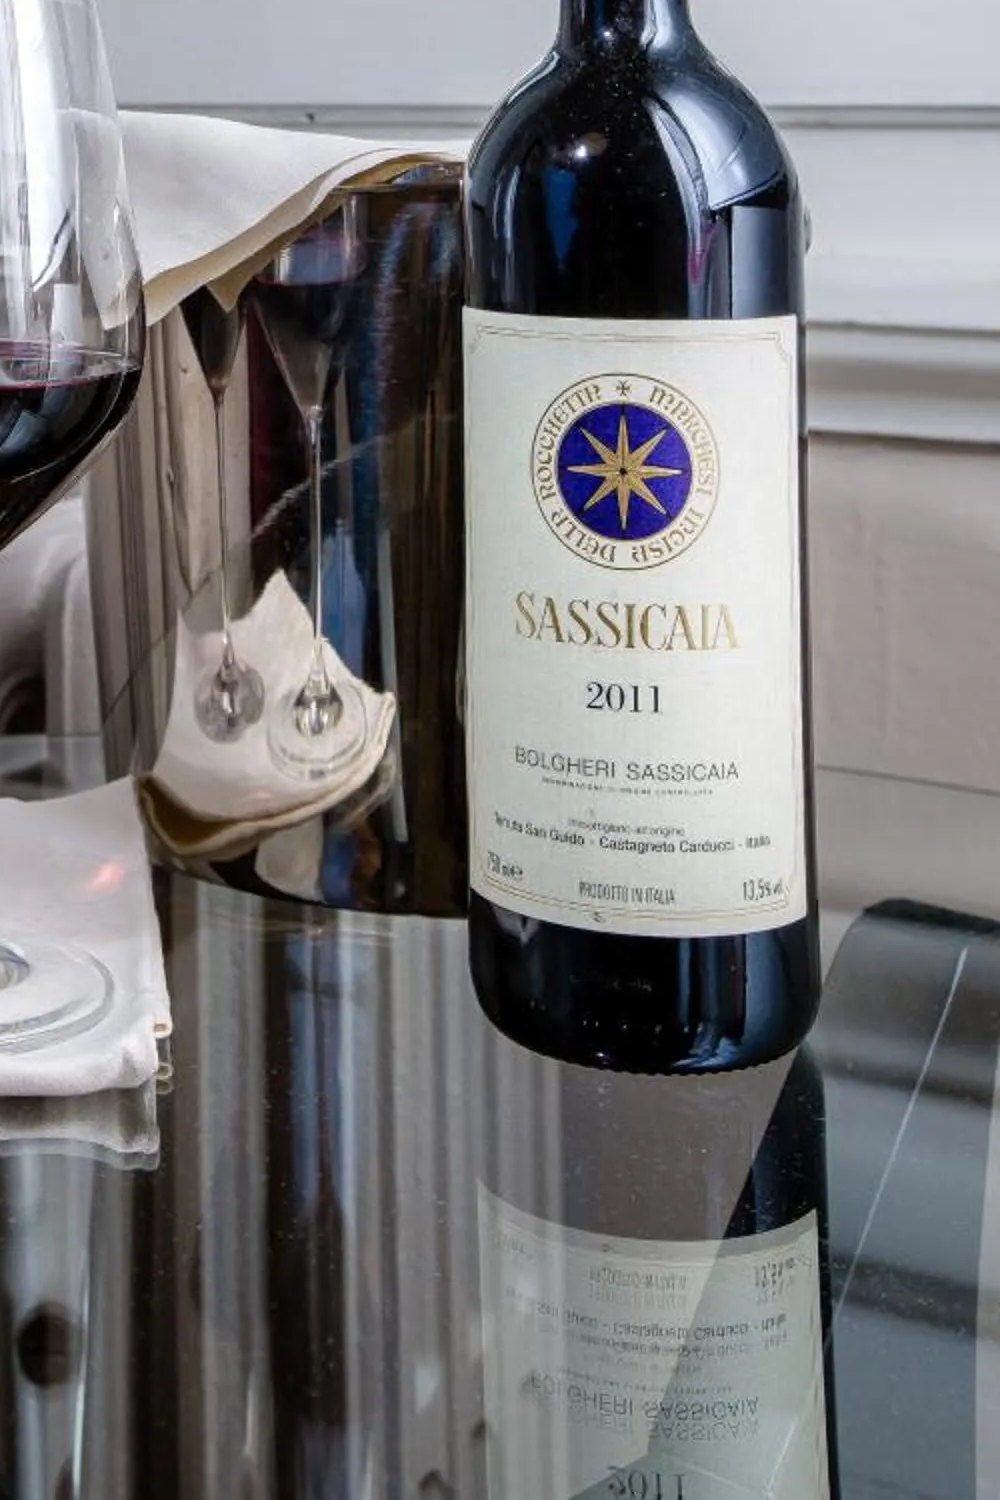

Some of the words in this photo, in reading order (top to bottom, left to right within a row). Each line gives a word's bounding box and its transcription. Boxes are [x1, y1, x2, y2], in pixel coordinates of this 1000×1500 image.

[535, 384, 602, 501] ROCCHETTA
[551, 508, 616, 564] DELLA
[514, 590, 741, 651] SASSICAIA
[586, 681, 663, 714] 2011
[514, 745, 616, 779] BOLGHERI
[625, 761, 741, 782] SASSICAIA
[525, 822, 547, 839] San
[549, 829, 585, 846] Guido
[599, 835, 676, 855] Castagneto
[679, 839, 736, 854] Carducci
[645, 887, 676, 906] ITALIA
